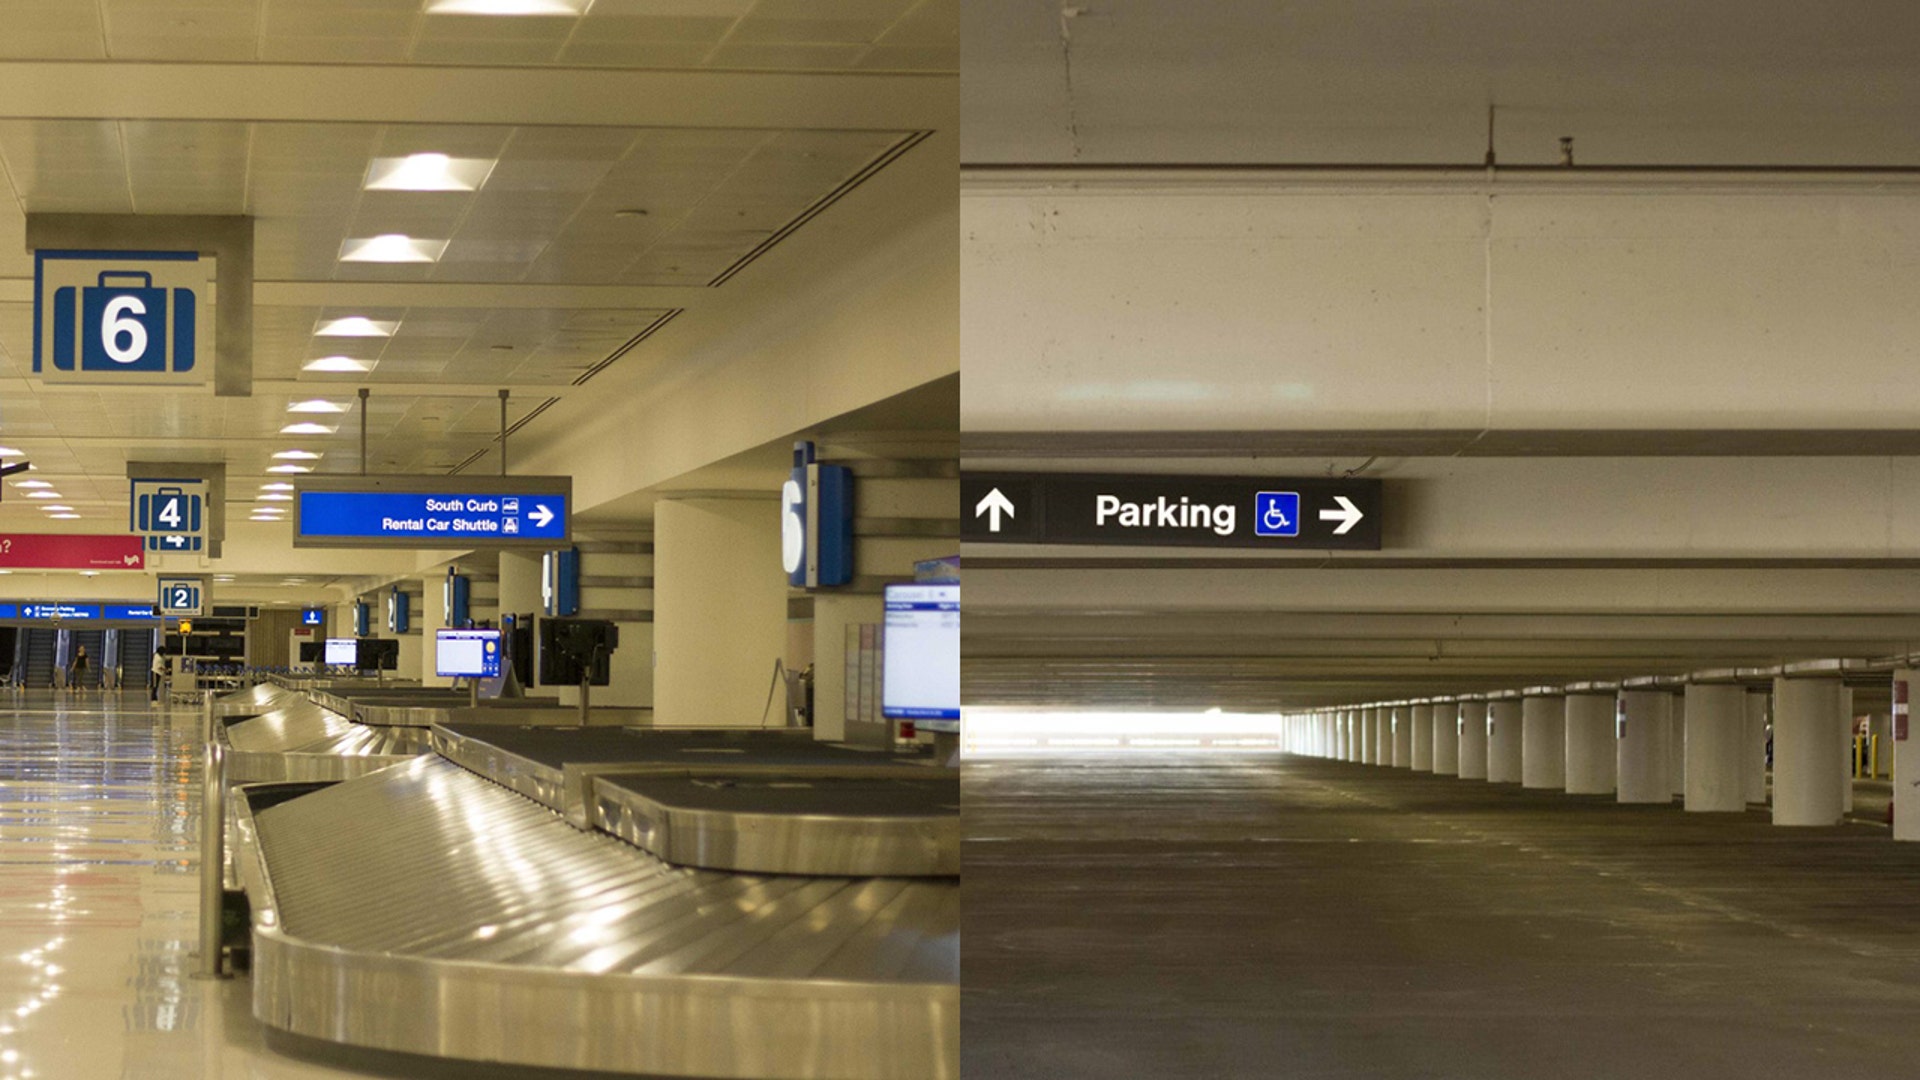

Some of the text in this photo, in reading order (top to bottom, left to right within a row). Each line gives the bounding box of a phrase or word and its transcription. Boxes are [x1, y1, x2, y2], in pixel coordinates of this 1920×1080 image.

[101, 295, 148, 363] 6
[158, 498, 181, 528] 4
[426, 499, 498, 512] South Curb
[1096, 495, 1236, 535] Parking
[382, 518, 498, 532] Rental Car Shuttle
[174, 590, 188, 607] 2
